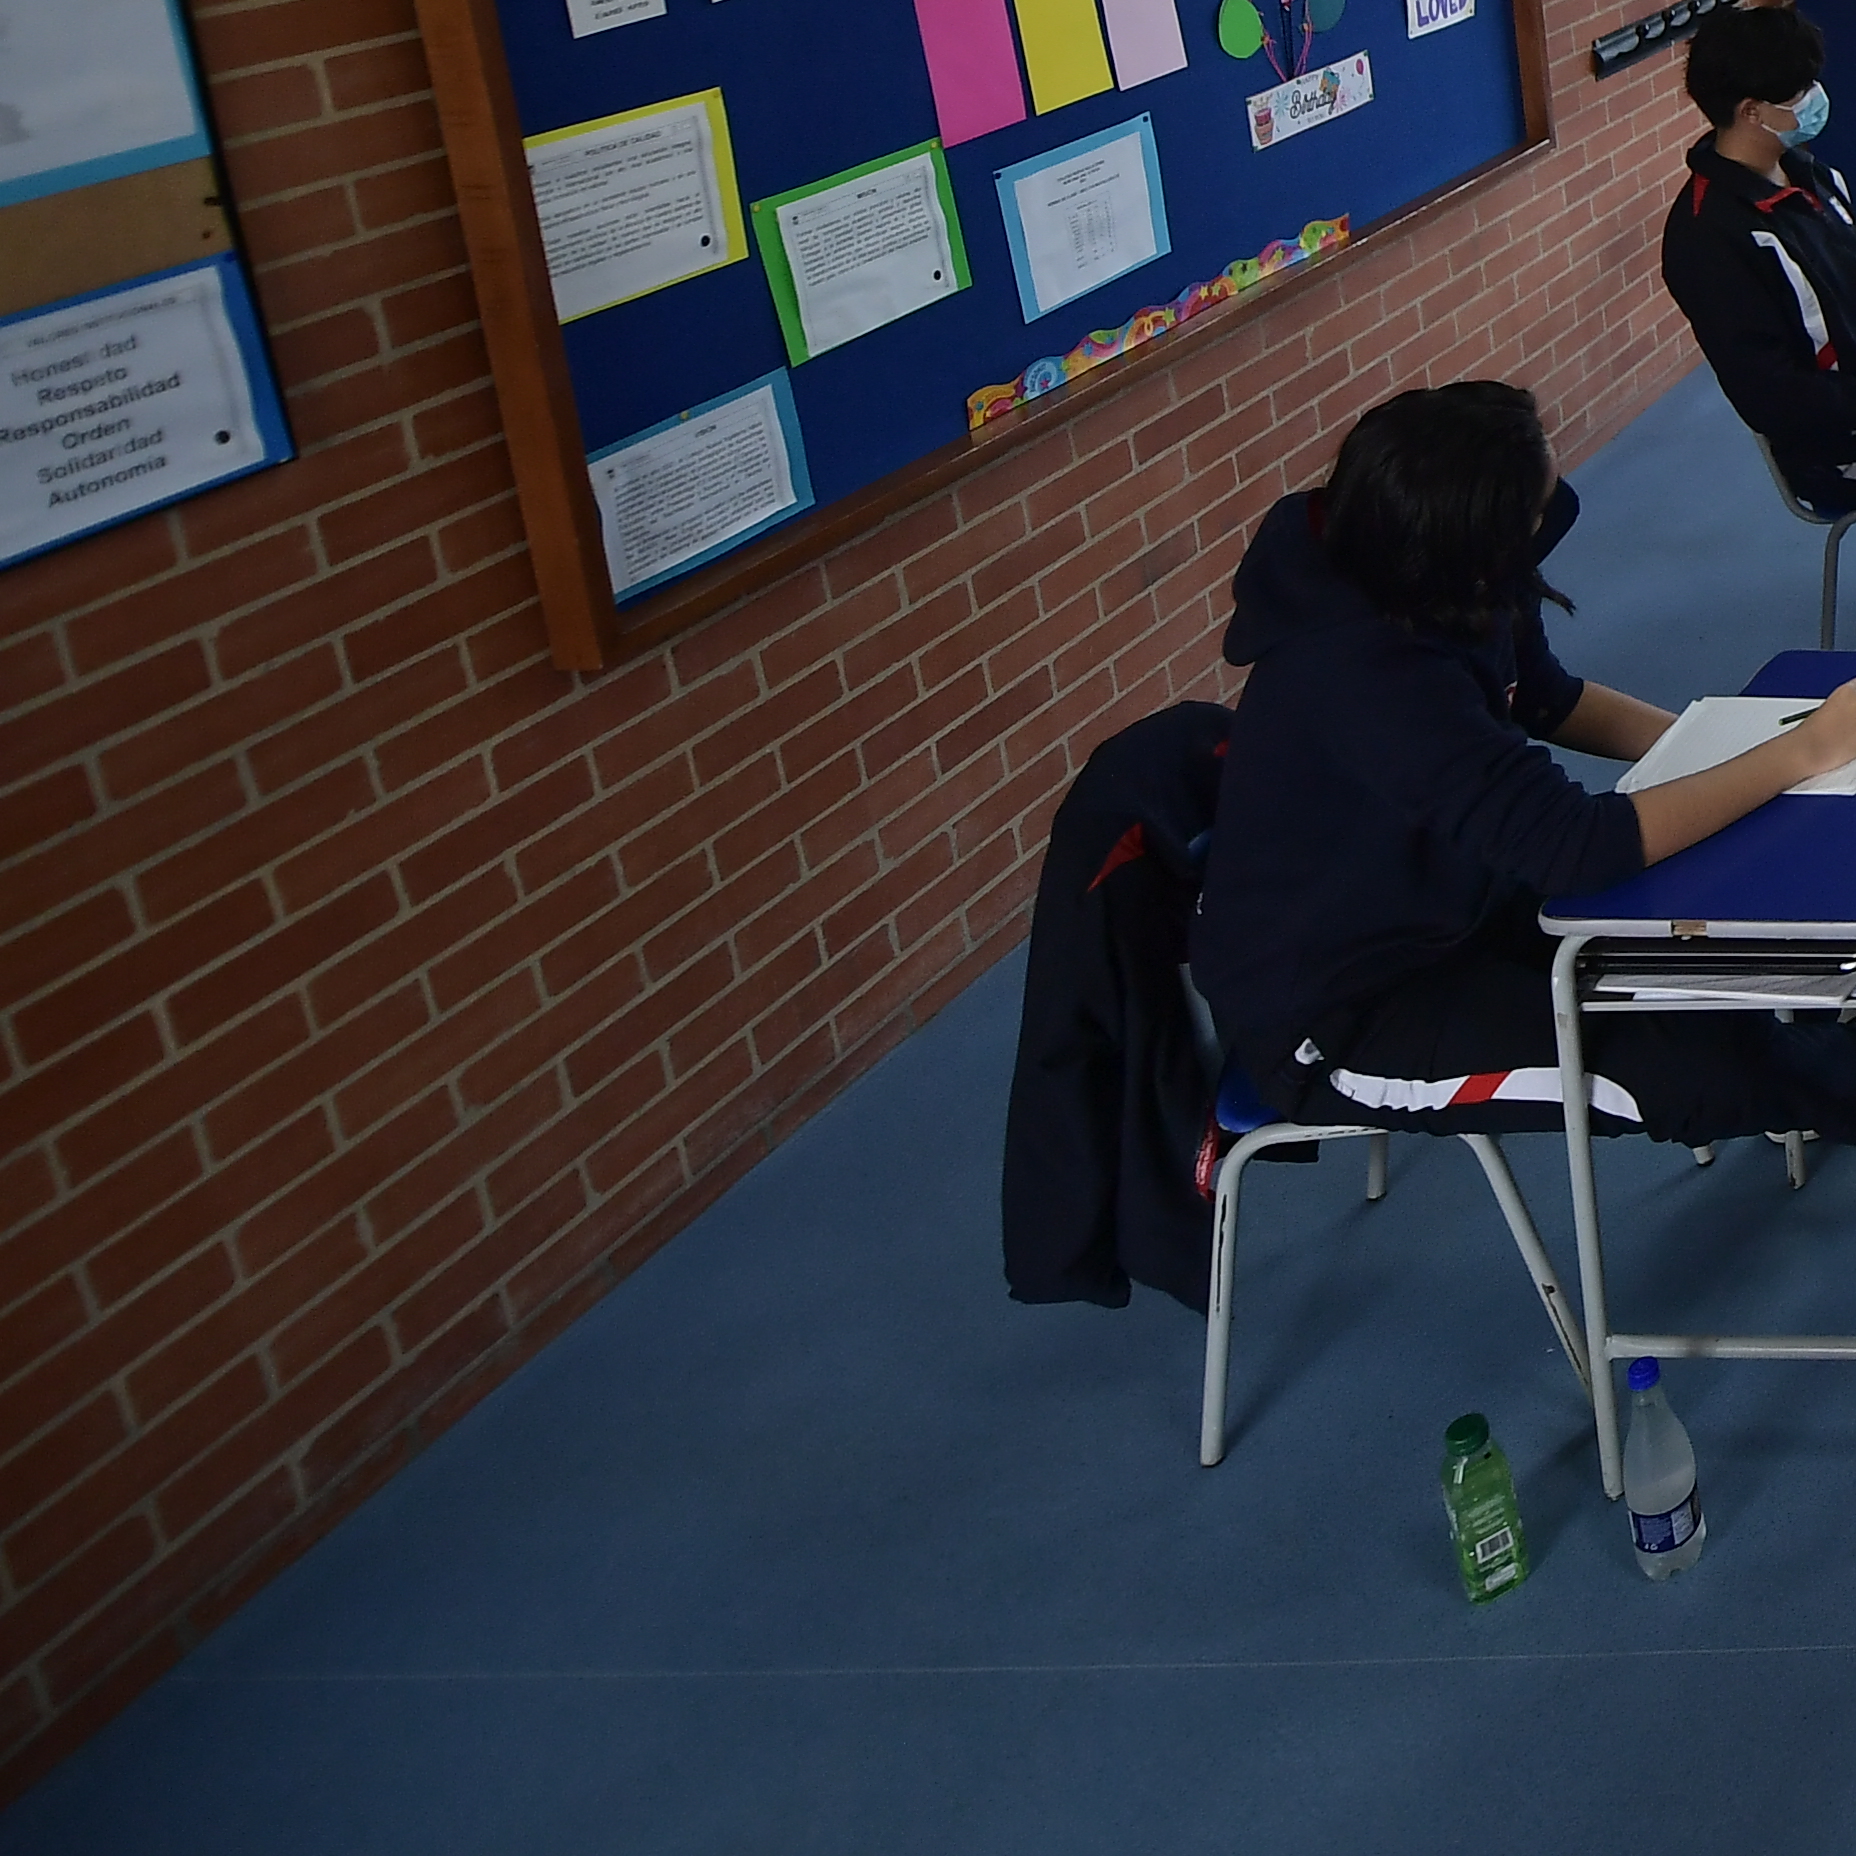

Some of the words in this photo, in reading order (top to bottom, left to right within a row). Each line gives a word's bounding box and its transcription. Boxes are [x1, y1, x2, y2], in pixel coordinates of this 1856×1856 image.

[1290, 89, 1337, 120] Birthday
[11, 334, 138, 387] Honesdad
[0, 370, 182, 444] Responsabilidad
[37, 366, 128, 405] Respeto
[62, 417, 131, 450] Orden
[37, 429, 164, 485] Solidardad
